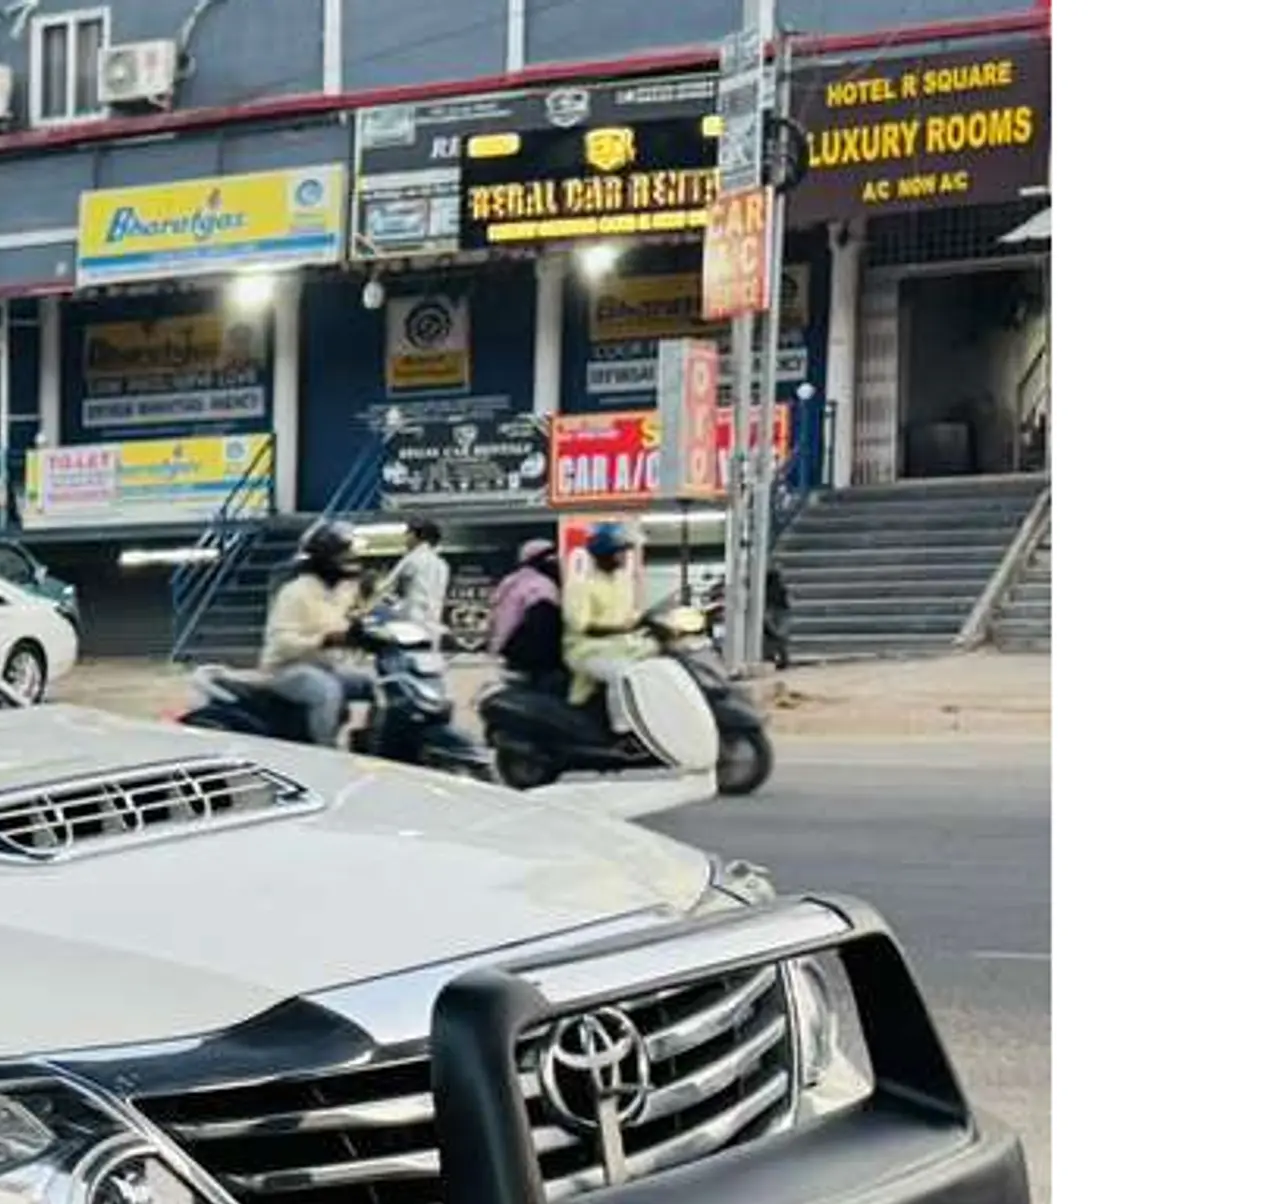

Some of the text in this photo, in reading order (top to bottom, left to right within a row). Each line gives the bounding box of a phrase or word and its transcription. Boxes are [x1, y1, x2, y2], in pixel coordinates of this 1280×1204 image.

[827, 61, 1013, 106] HOTEL R SQUARE
[807, 106, 1033, 167] LUXURY ROOMS
[898, 174, 936, 198] NON
[106, 206, 246, 242] Bharatgas
[559, 454, 607, 493] CAR
